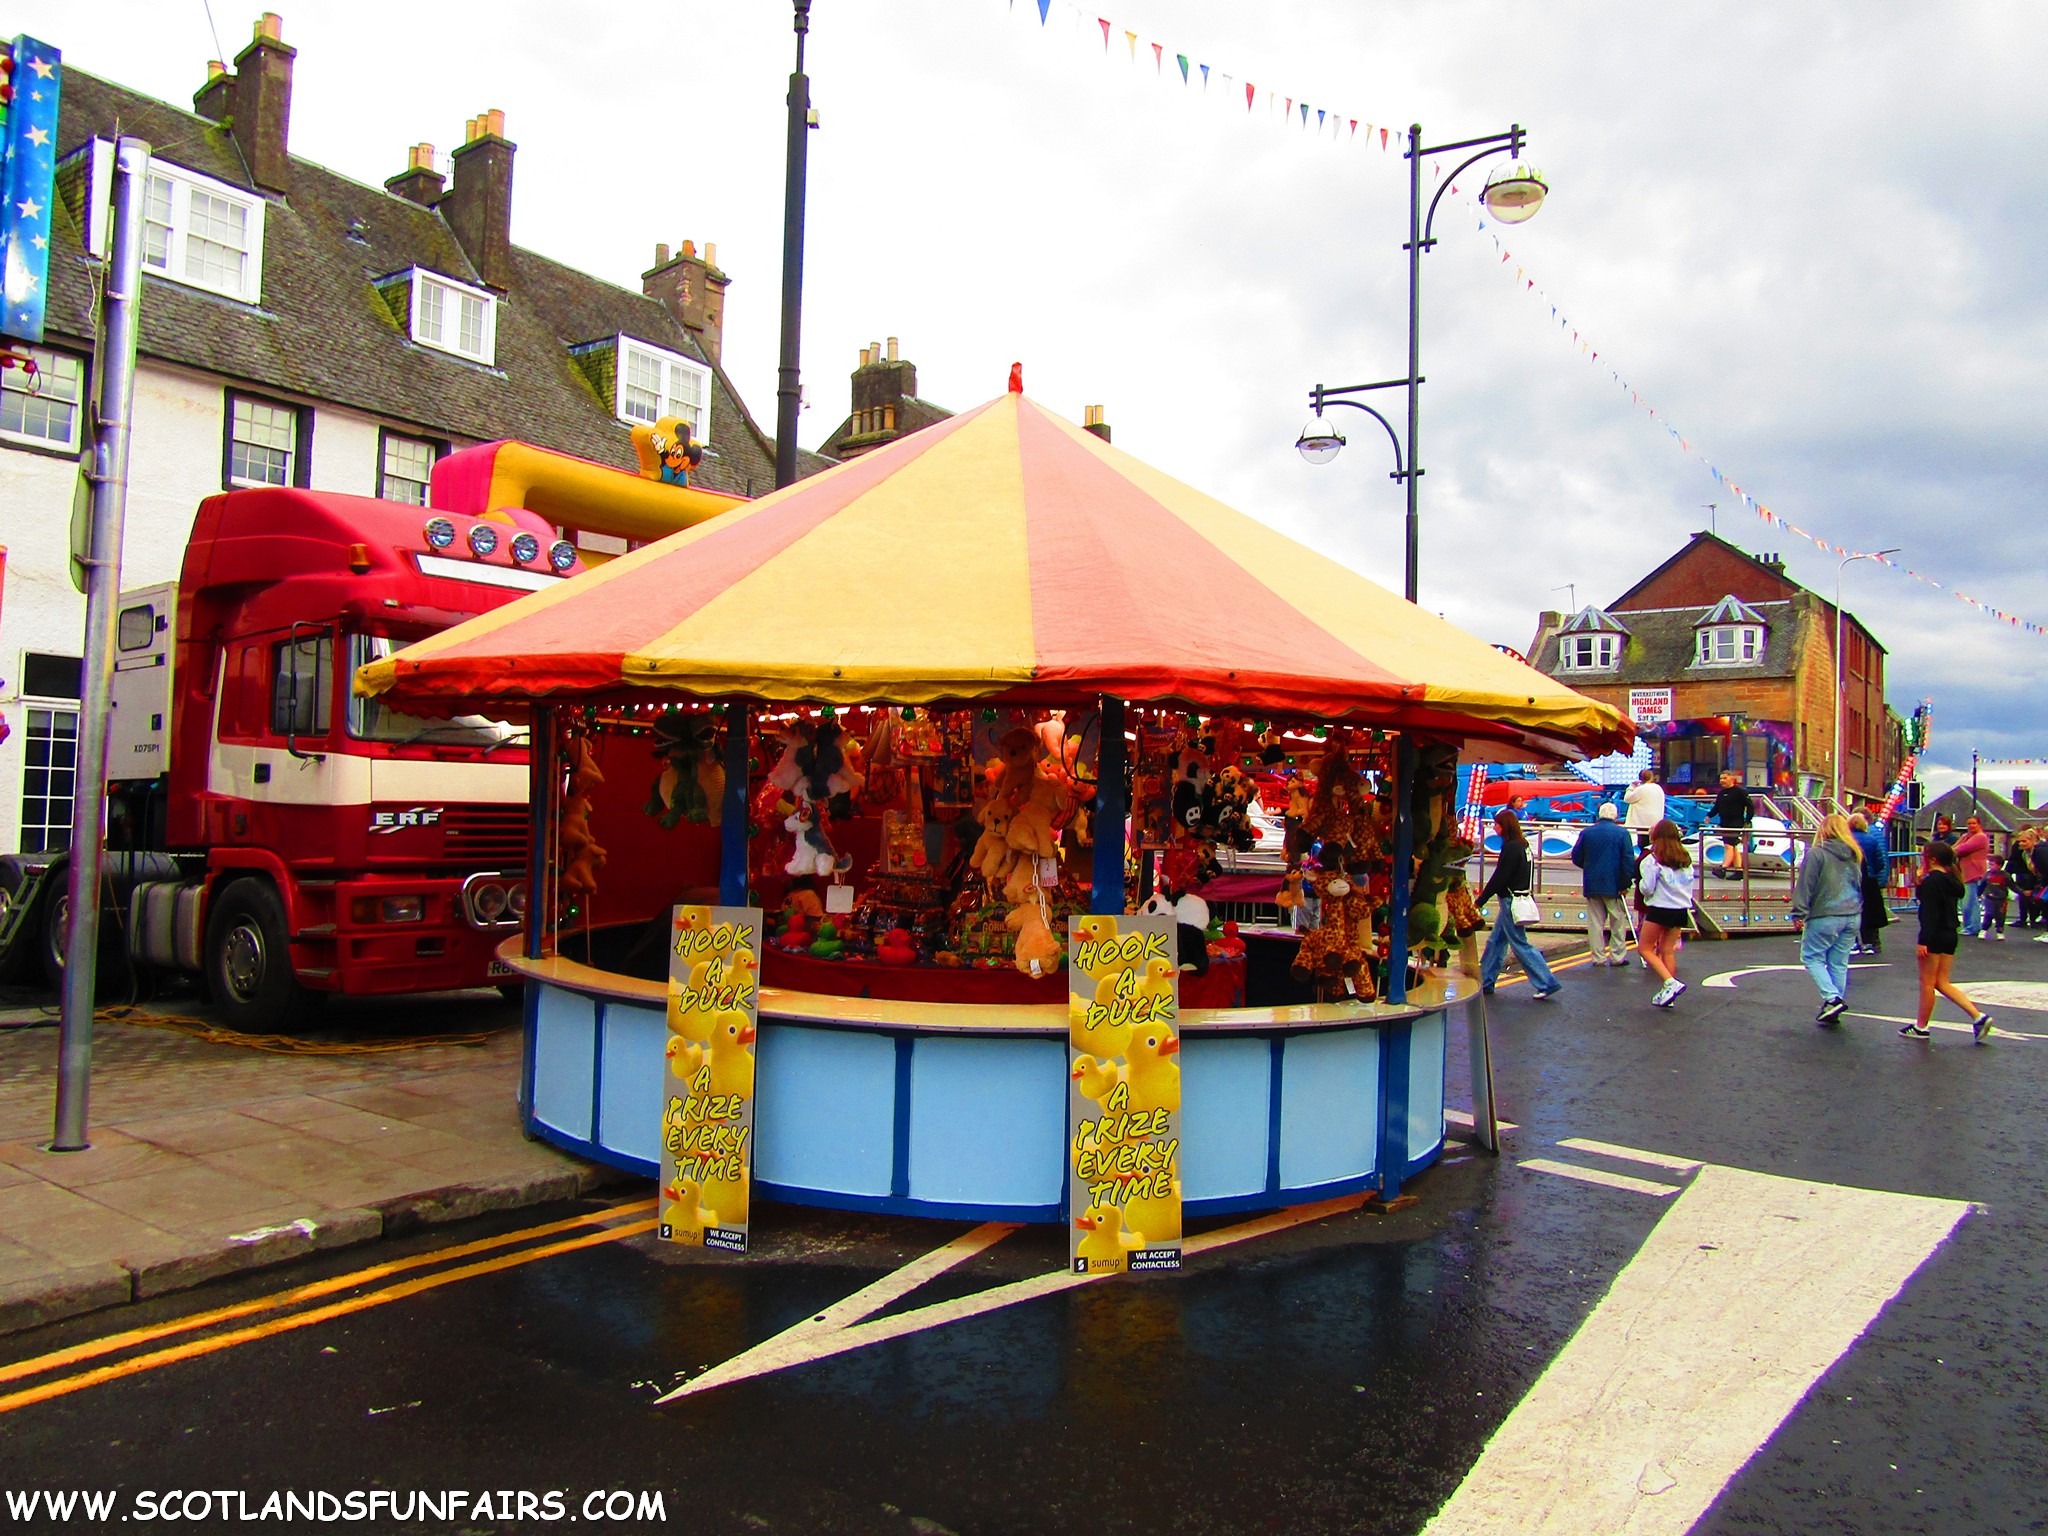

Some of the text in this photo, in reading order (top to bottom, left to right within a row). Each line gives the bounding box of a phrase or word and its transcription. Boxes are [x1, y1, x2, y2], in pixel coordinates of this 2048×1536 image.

[1637, 706, 1662, 714] GAMES
[375, 812, 439, 825] ERF
[1042, 875, 1057, 886] WINS
[674, 923, 754, 957] HOOK
[1073, 932, 1170, 970] HOOK
[705, 956, 723, 983] A
[1114, 967, 1135, 996] A
[679, 983, 754, 1014] DUCK
[1085, 993, 1175, 1031] DUCK
[693, 1065, 711, 1092] A
[667, 1093, 744, 1124] PRIZE
[1108, 1081, 1129, 1112] A
[666, 1124, 749, 1154] EVERY
[1076, 1107, 1170, 1150] PRIZE
[674, 1155, 743, 1182] TIME
[1076, 1138, 1179, 1179] EVERY
[1088, 1170, 1172, 1209] TIME
[675, 1229, 698, 1241] sumup
[706, 1238, 745, 1252] CONTACTLESS
[709, 1229, 742, 1241] WE ACCEPT
[1092, 1258, 1120, 1269] sumup
[1131, 1260, 1180, 1270] CONTACTLESS
[1135, 1250, 1176, 1260] WE ACCEPT
